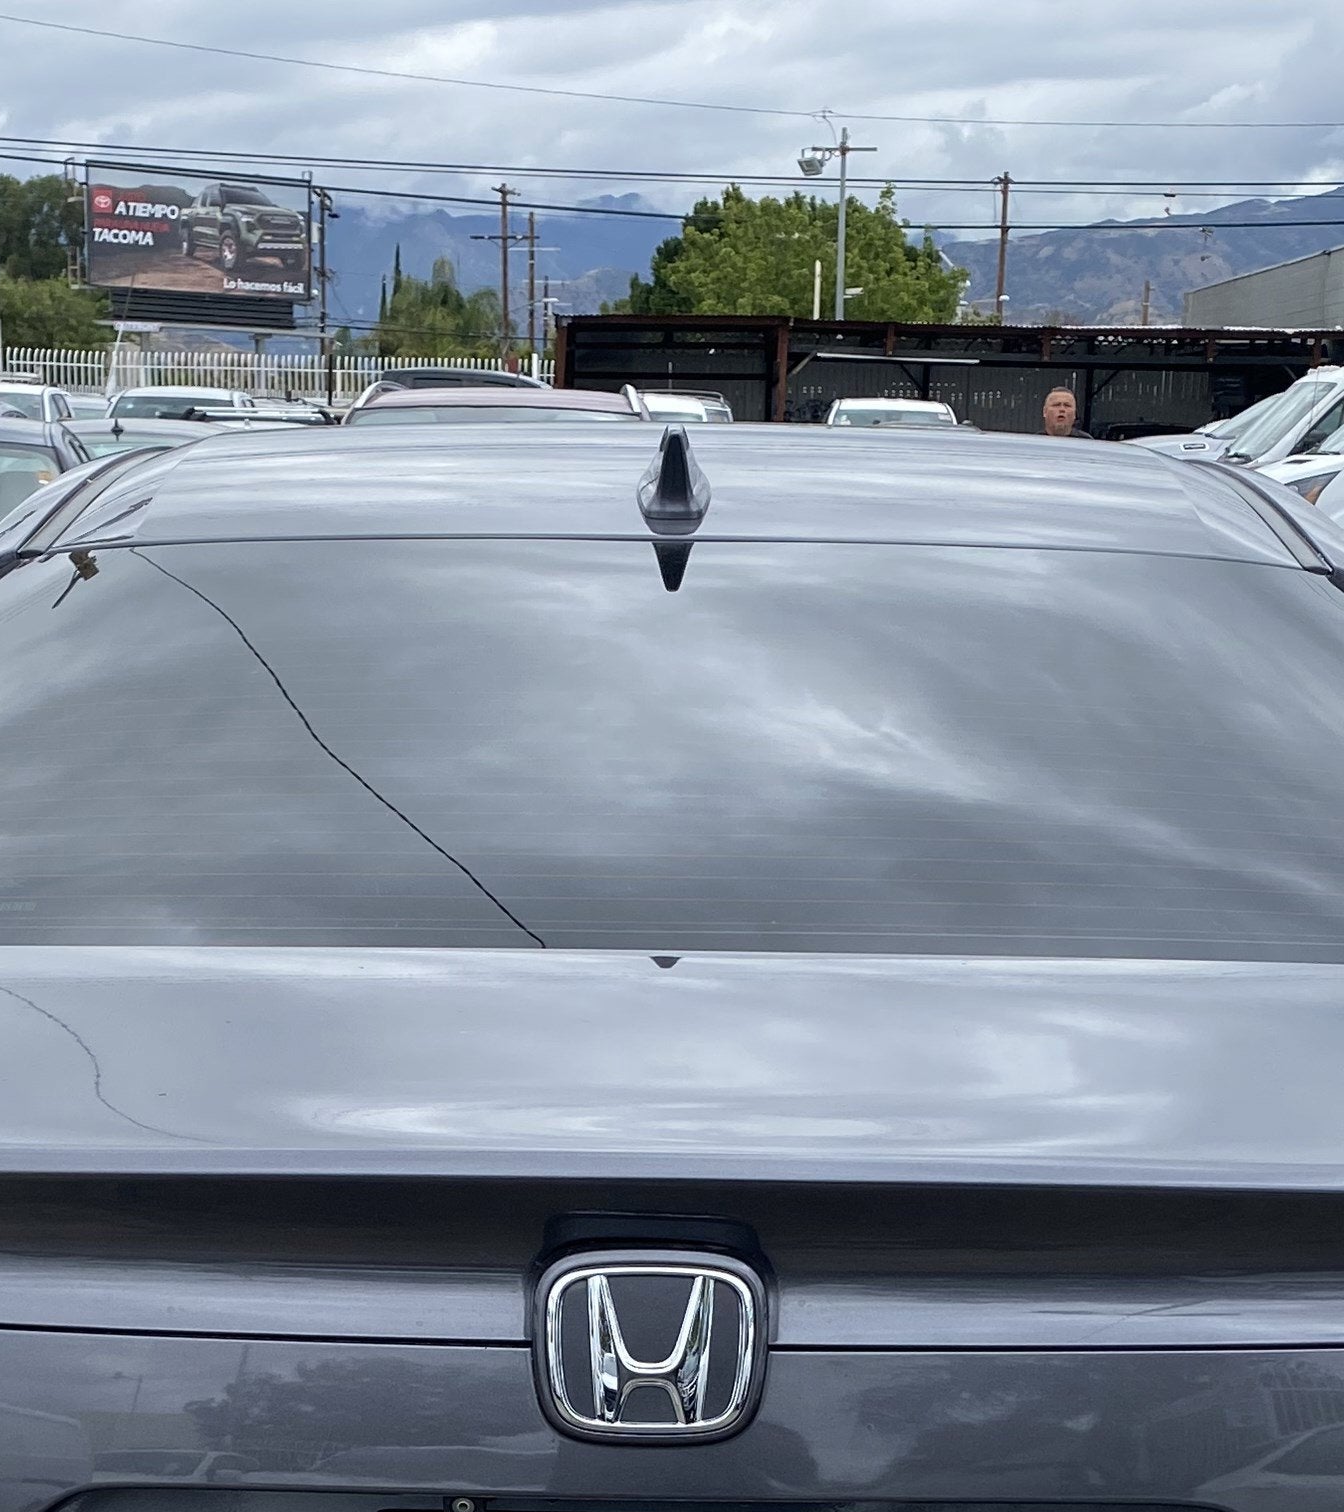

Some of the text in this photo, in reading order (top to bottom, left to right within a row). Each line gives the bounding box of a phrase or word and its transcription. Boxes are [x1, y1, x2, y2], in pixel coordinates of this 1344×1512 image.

[114, 201, 179, 219] A TIEMPO
[93, 227, 154, 246] TACOMA
[223, 278, 236, 289] Lo
[237, 278, 282, 292] hacemos
